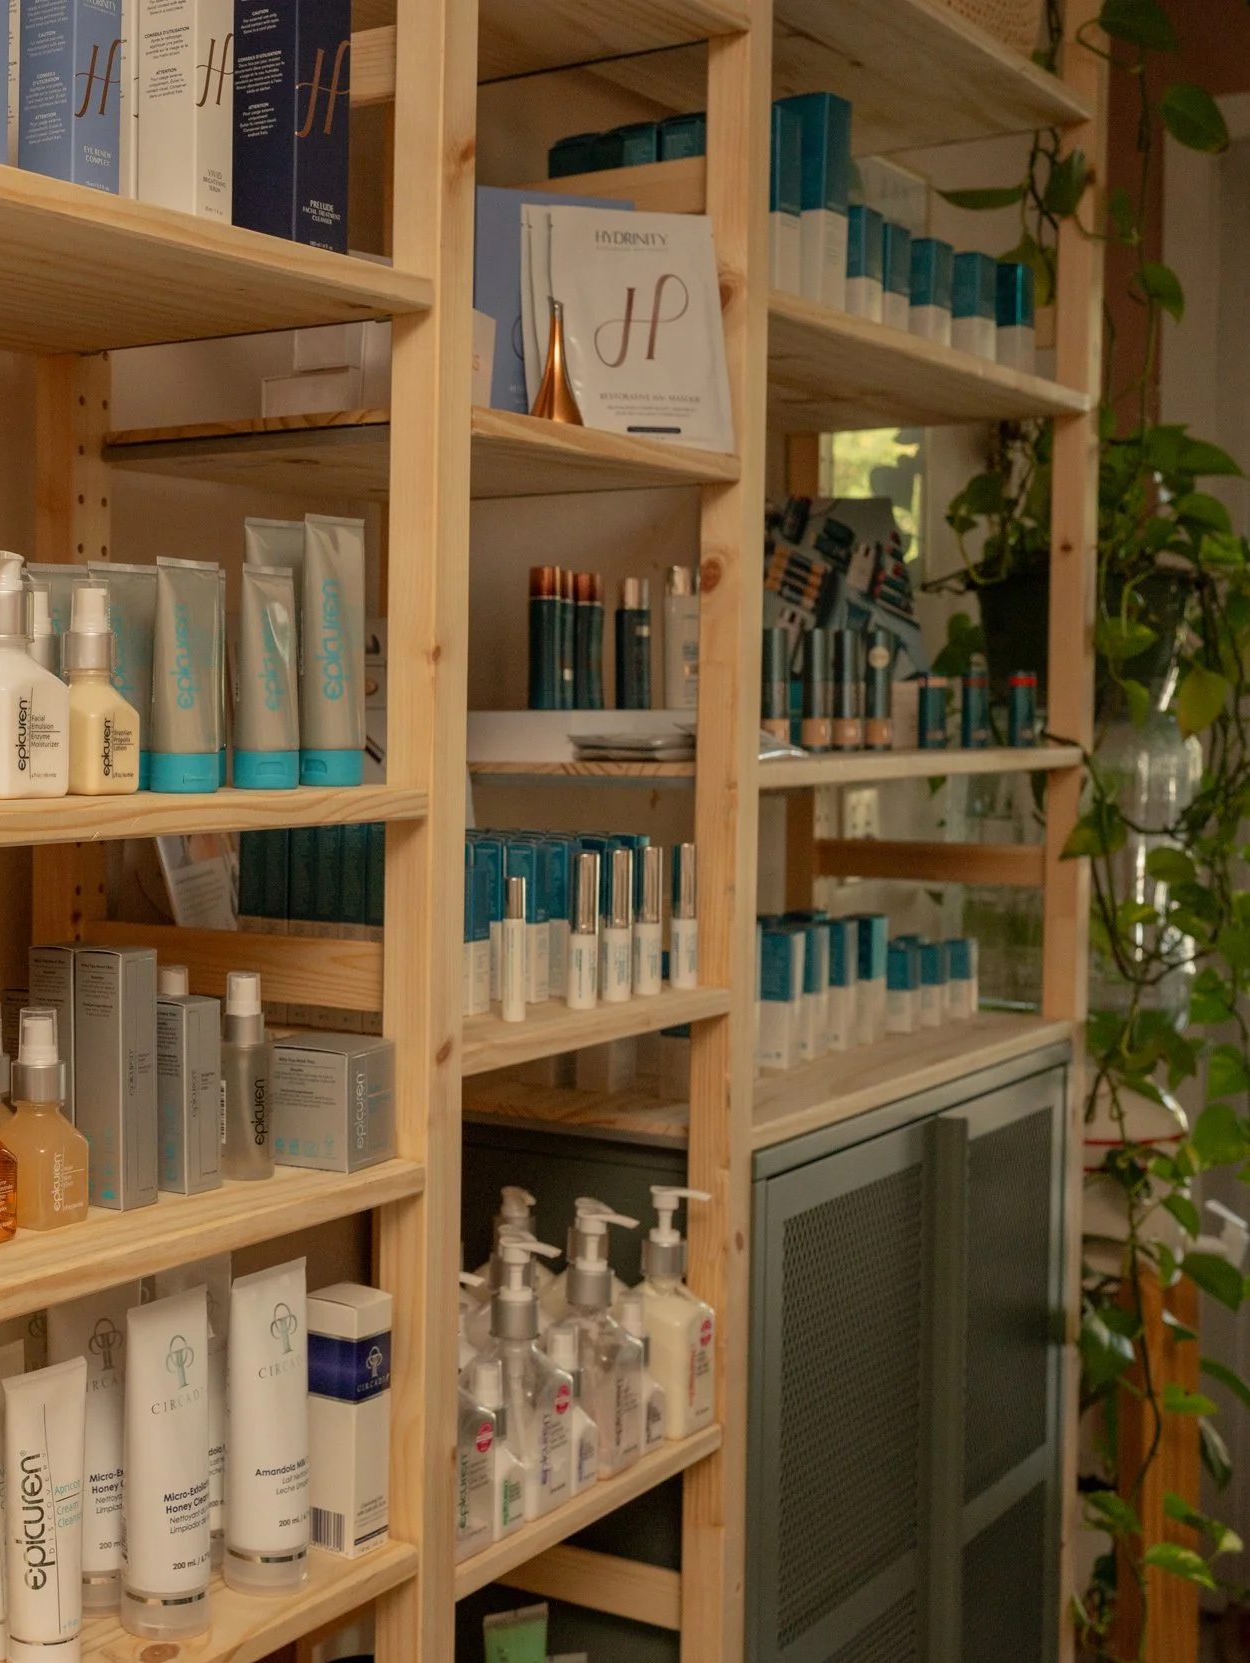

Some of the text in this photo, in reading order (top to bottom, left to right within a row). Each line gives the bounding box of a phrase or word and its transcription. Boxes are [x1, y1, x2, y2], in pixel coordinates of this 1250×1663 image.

[310, 199, 335, 213] PRELUDE
[594, 229, 669, 247] HYDRINITY
[314, 578, 349, 701] epicuren
[31, 714, 46, 722] Facial
[31, 722, 54, 731] Emulsion
[15, 699, 30, 772] epicuren
[31, 733, 50, 742] Enzyme
[31, 741, 60, 749] Moisturizer
[101, 719, 114, 778] epicuren
[250, 1078, 269, 1146] epicuren
[354, 1072, 367, 1150] epicuren
[255, 1463, 296, 1477] Amandola
[54, 1480, 81, 1496] Apricot
[92, 1483, 115, 1495] Honey
[56, 1500, 80, 1515] Cream
[166, 1501, 192, 1514] Honey
[14, 1451, 56, 1591] epicuren
[279, 1518, 291, 1527] 200
[99, 1541, 112, 1550] 200
[172, 1561, 186, 1570] 200
